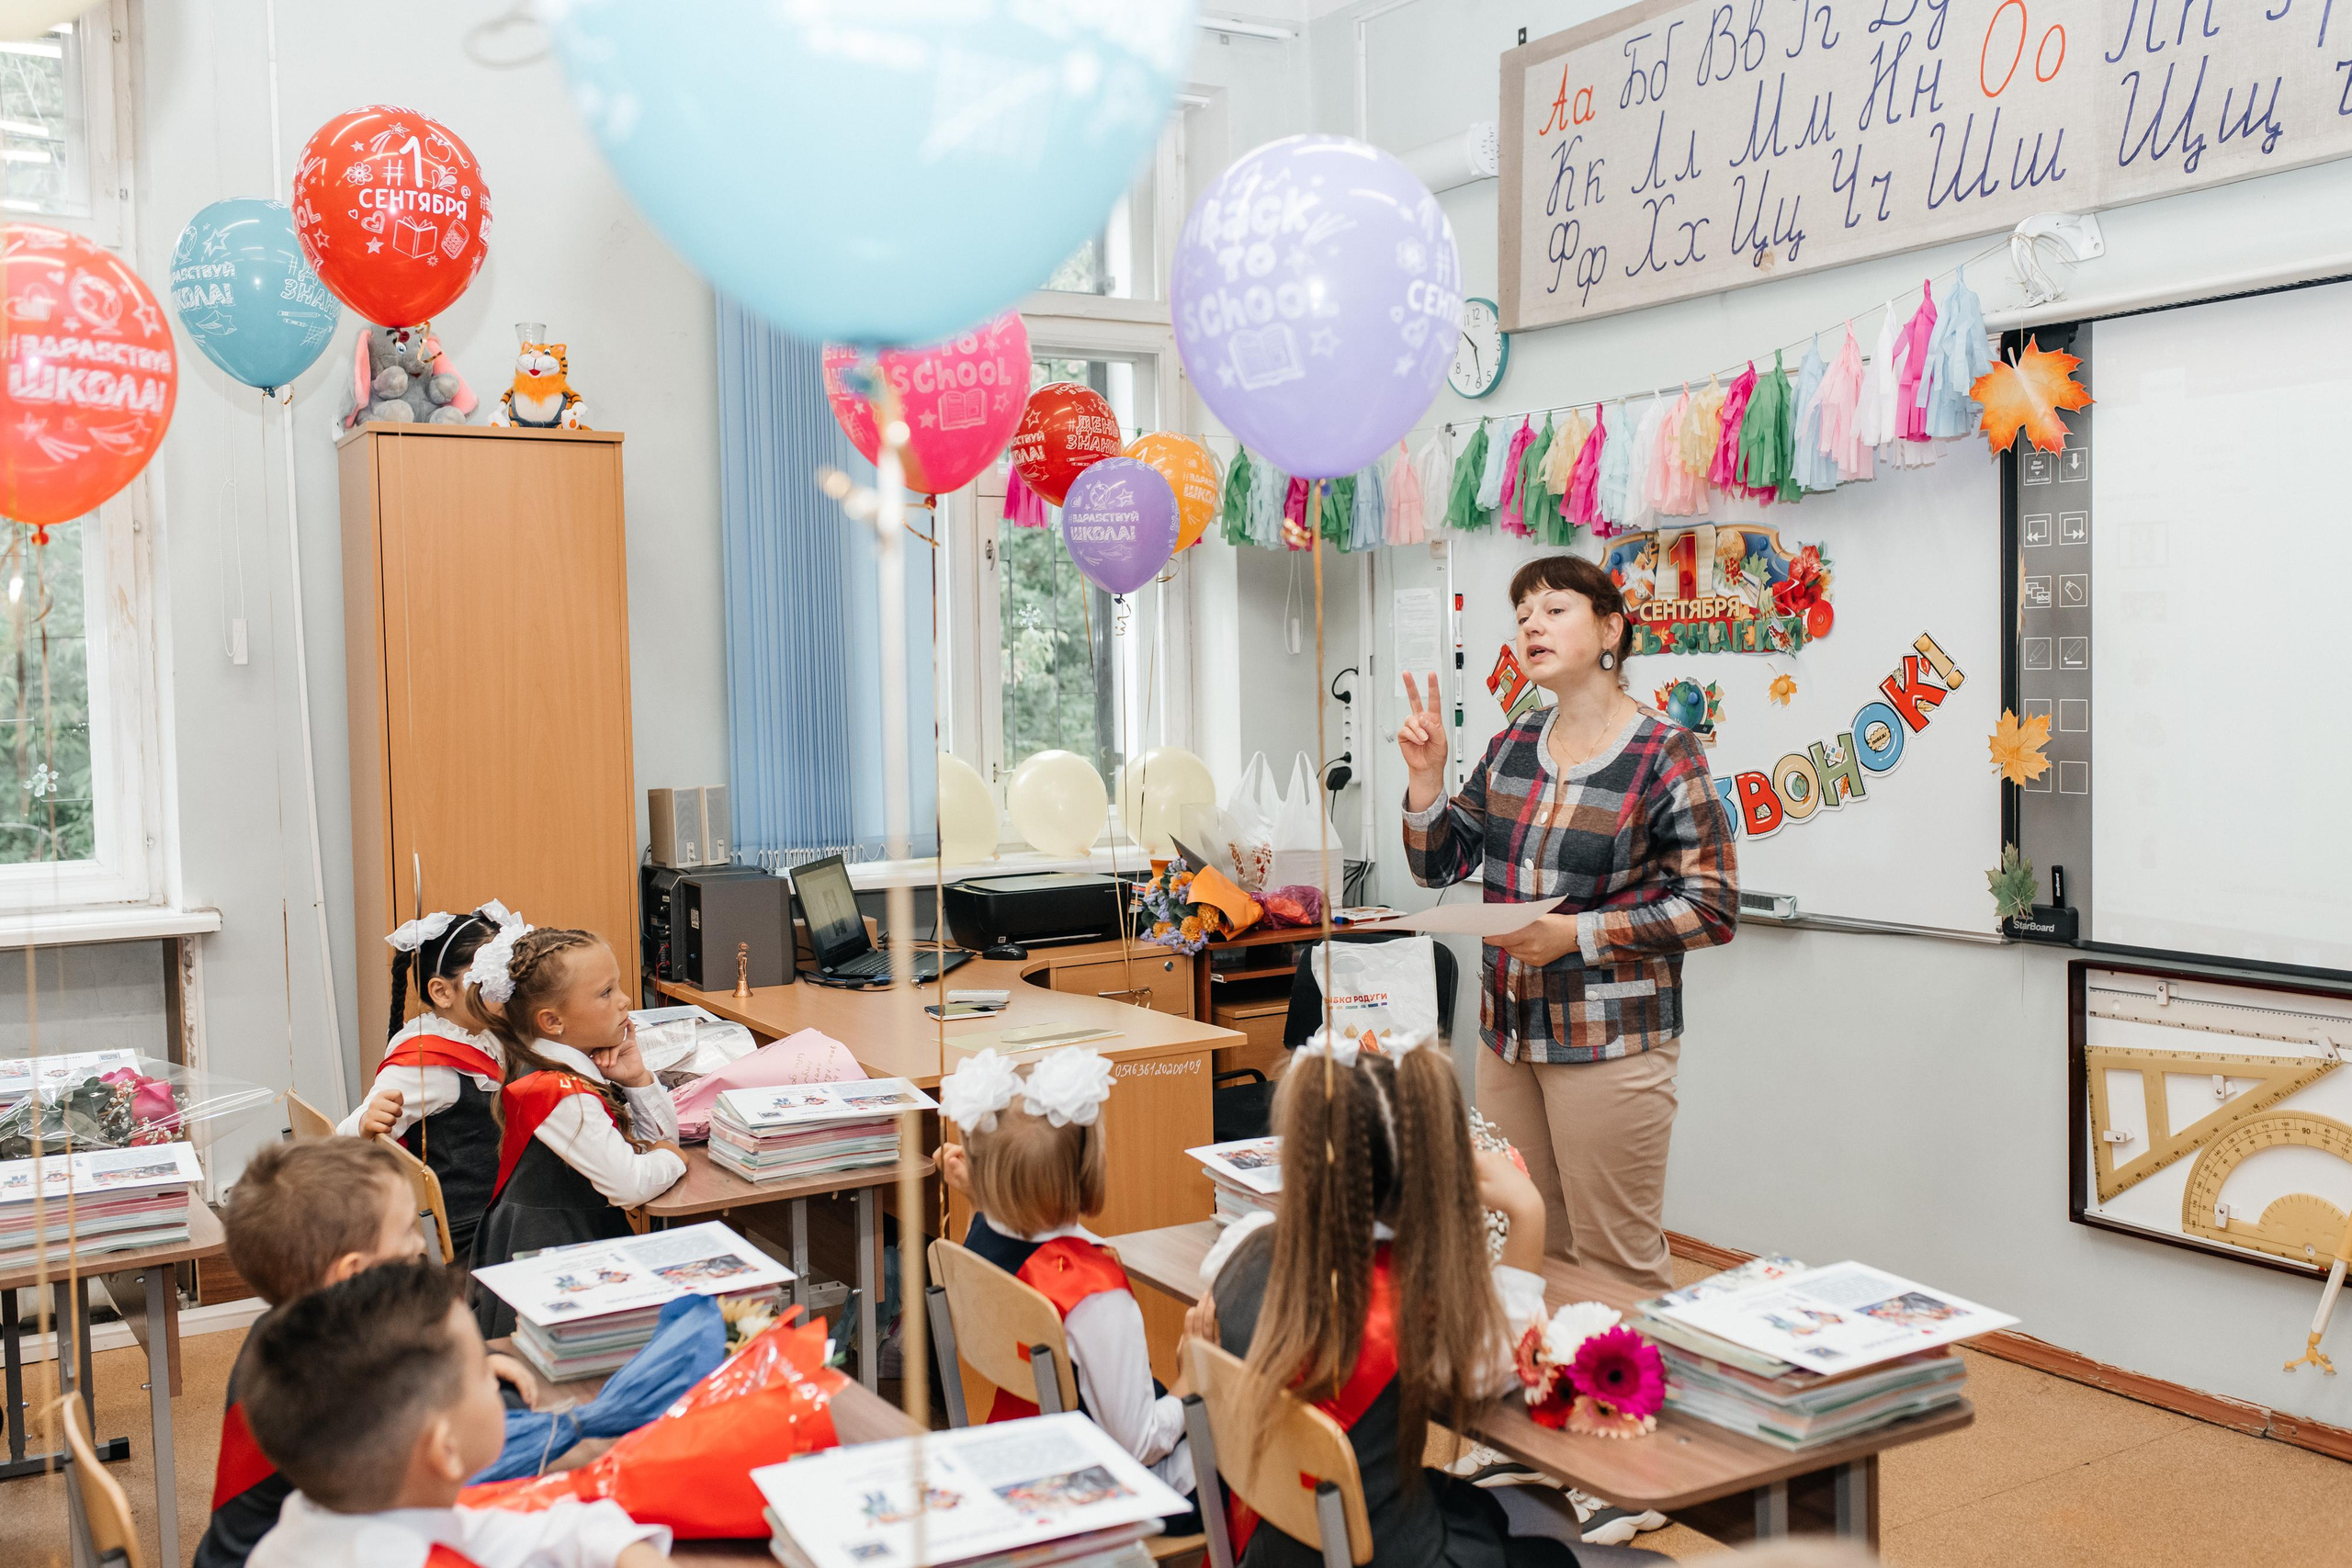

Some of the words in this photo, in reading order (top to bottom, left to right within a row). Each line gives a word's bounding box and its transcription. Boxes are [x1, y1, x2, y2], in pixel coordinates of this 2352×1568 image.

[1539, 63, 1596, 136] Аа
[1620, 20, 1684, 108] Бб
[1697, 4, 1765, 86] Вв
[1546, 134, 1606, 216] Кк
[1632, 110, 1702, 194] Лл
[1729, 73, 1836, 168] Мм
[1859, 30, 1944, 131] Нн
[1981, 0, 2066, 97] Оо
[382, 135, 424, 188] #1
[1547, 219, 1608, 308] Фф
[1625, 194, 1710, 277] Хх
[1731, 170, 1806, 268] Цц
[1831, 143, 1893, 229] Чч
[1928, 107, 2067, 209] Шш
[2118, 54, 2284, 174] Щщ
[358, 188, 467, 221] СЕНТЯБРЯ
[1217, 242, 1277, 283] TO
[1407, 279, 1463, 329] СЕНТ
[1473, 308, 1480, 320] 12
[1465, 375, 1470, 386] 7
[1487, 371, 1492, 382] 5
[1068, 415, 1119, 437] #ДЕНЬ
[1668, 531, 1706, 600] 1
[1639, 596, 1740, 622] СЕНТЯБРЯ
[2014, 920, 2054, 932] StarBoard
[2301, 1127, 2312, 1135] 90
